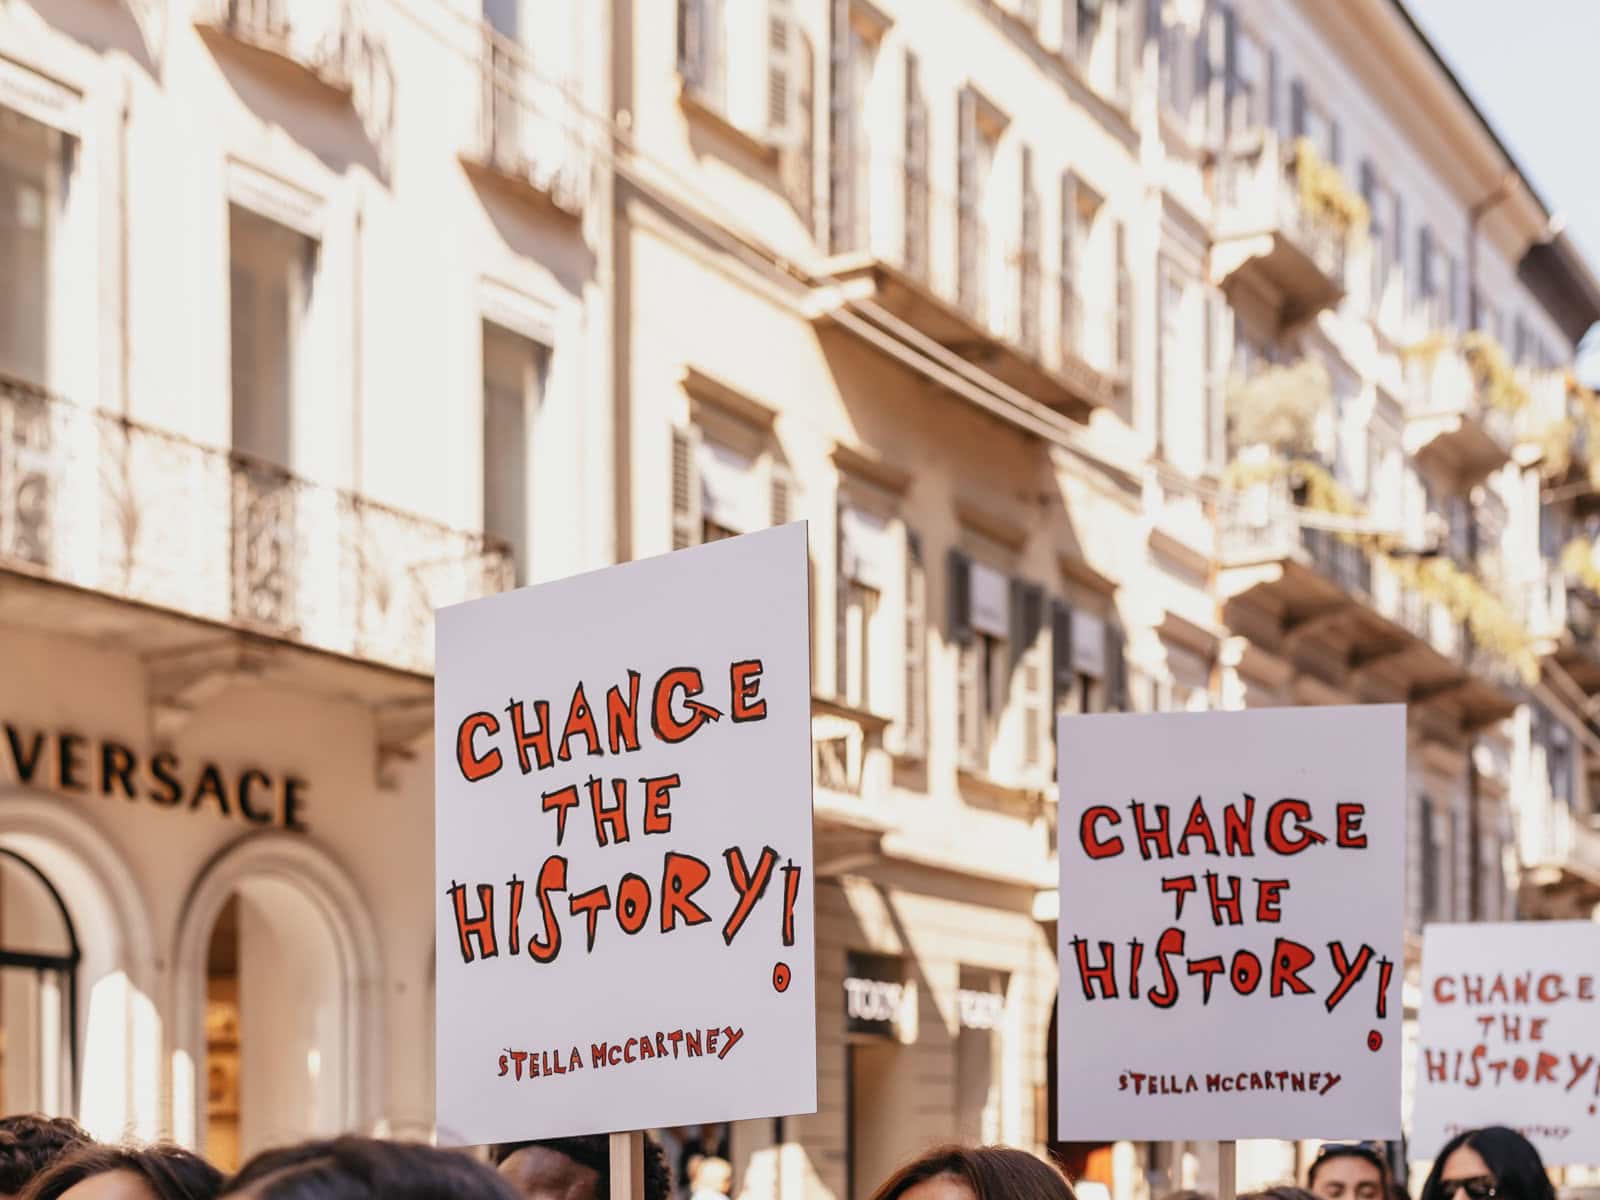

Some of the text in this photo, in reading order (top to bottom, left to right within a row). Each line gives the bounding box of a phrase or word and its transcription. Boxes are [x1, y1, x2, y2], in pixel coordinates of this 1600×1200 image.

[456, 659, 767, 782] CHANGE
[2, 721, 310, 835] VERSACE
[541, 774, 681, 847] THE
[1080, 793, 1367, 860] CHANGE
[447, 846, 801, 992] HISTORY!
[1161, 869, 1290, 926] THE
[1069, 928, 1393, 1052] HISTORY!
[1433, 970, 1595, 1005] CHANGE
[1477, 1013, 1548, 1041] THE
[497, 1047, 583, 1081] STELLA
[1118, 1070, 1198, 1096] STELLA
